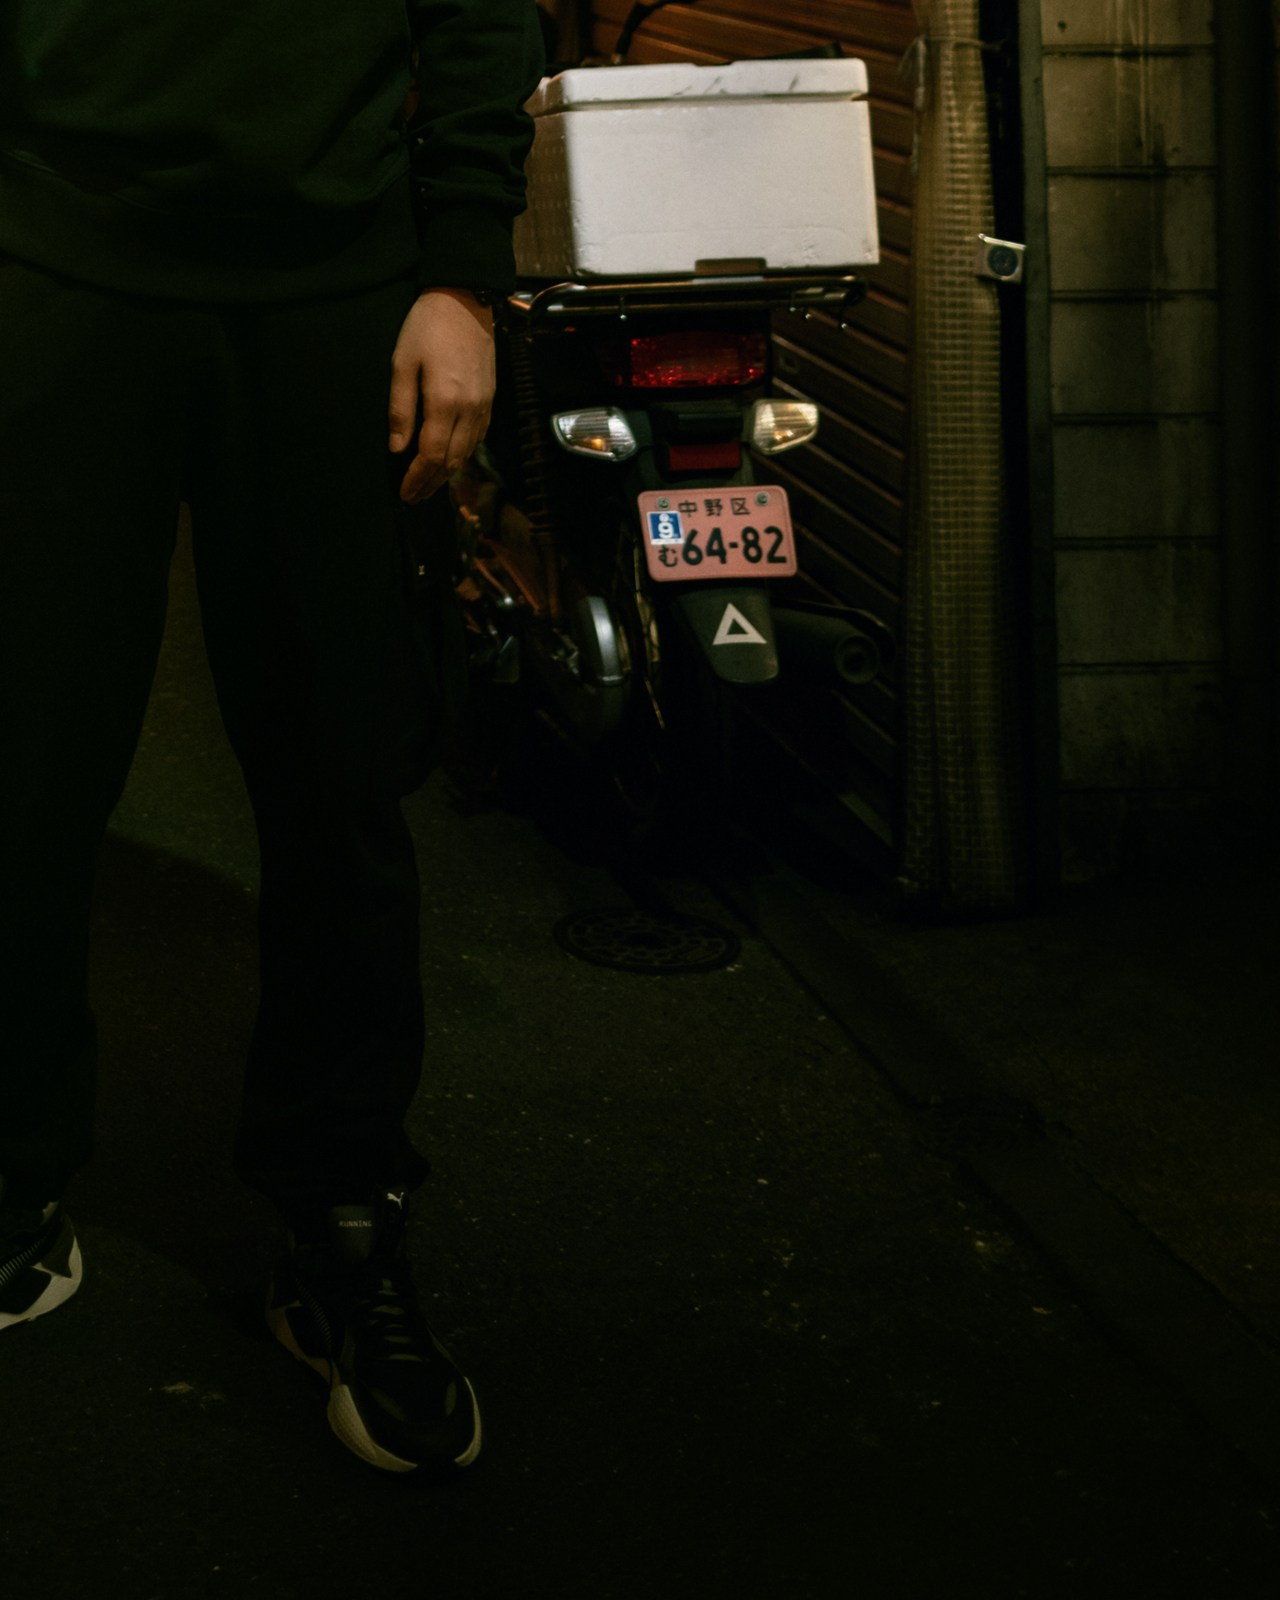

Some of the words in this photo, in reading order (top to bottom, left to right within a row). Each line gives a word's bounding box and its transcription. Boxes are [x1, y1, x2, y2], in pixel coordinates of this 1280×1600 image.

[678, 497, 751, 517] 中野区
[658, 545, 678, 567] む
[682, 525, 787, 566] 64-82
